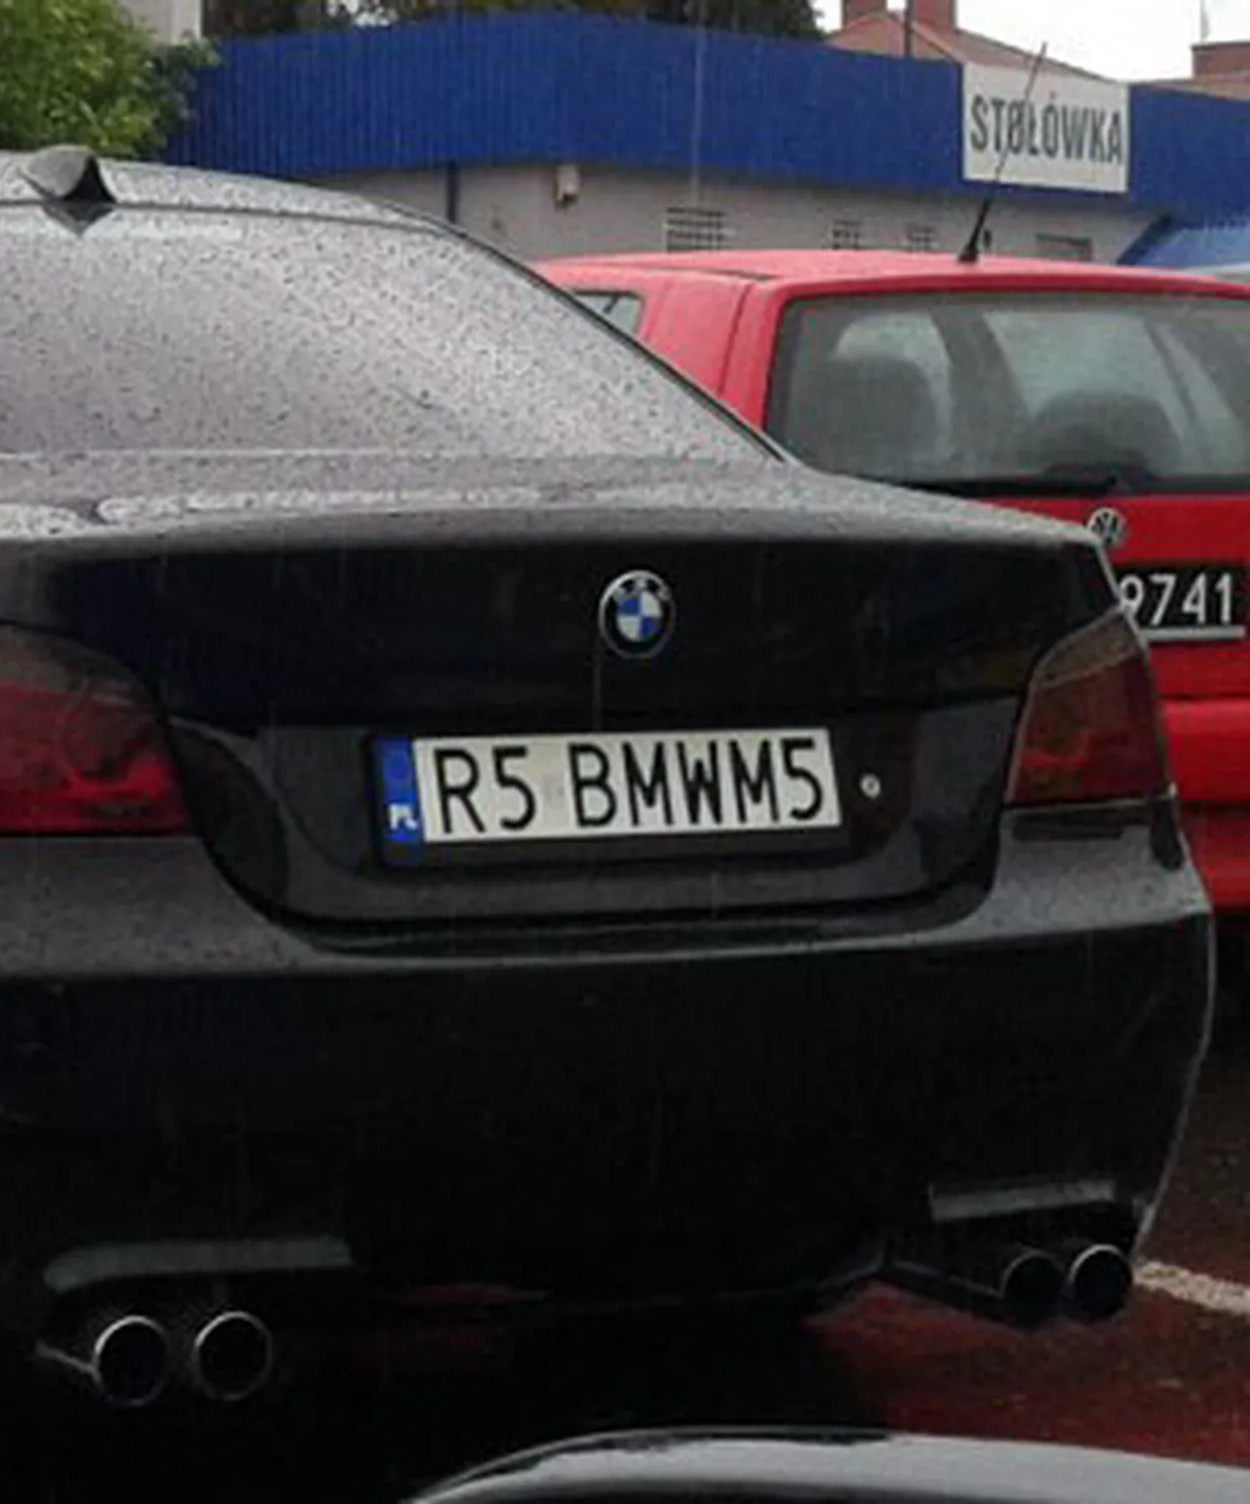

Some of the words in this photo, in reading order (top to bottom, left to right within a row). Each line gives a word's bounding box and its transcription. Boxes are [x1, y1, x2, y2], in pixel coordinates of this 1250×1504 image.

[970, 90, 1122, 165] STOŁÓWKA
[1119, 572, 1232, 626] 9741
[433, 746, 538, 834] R5
[568, 737, 825, 828] BMWM5
